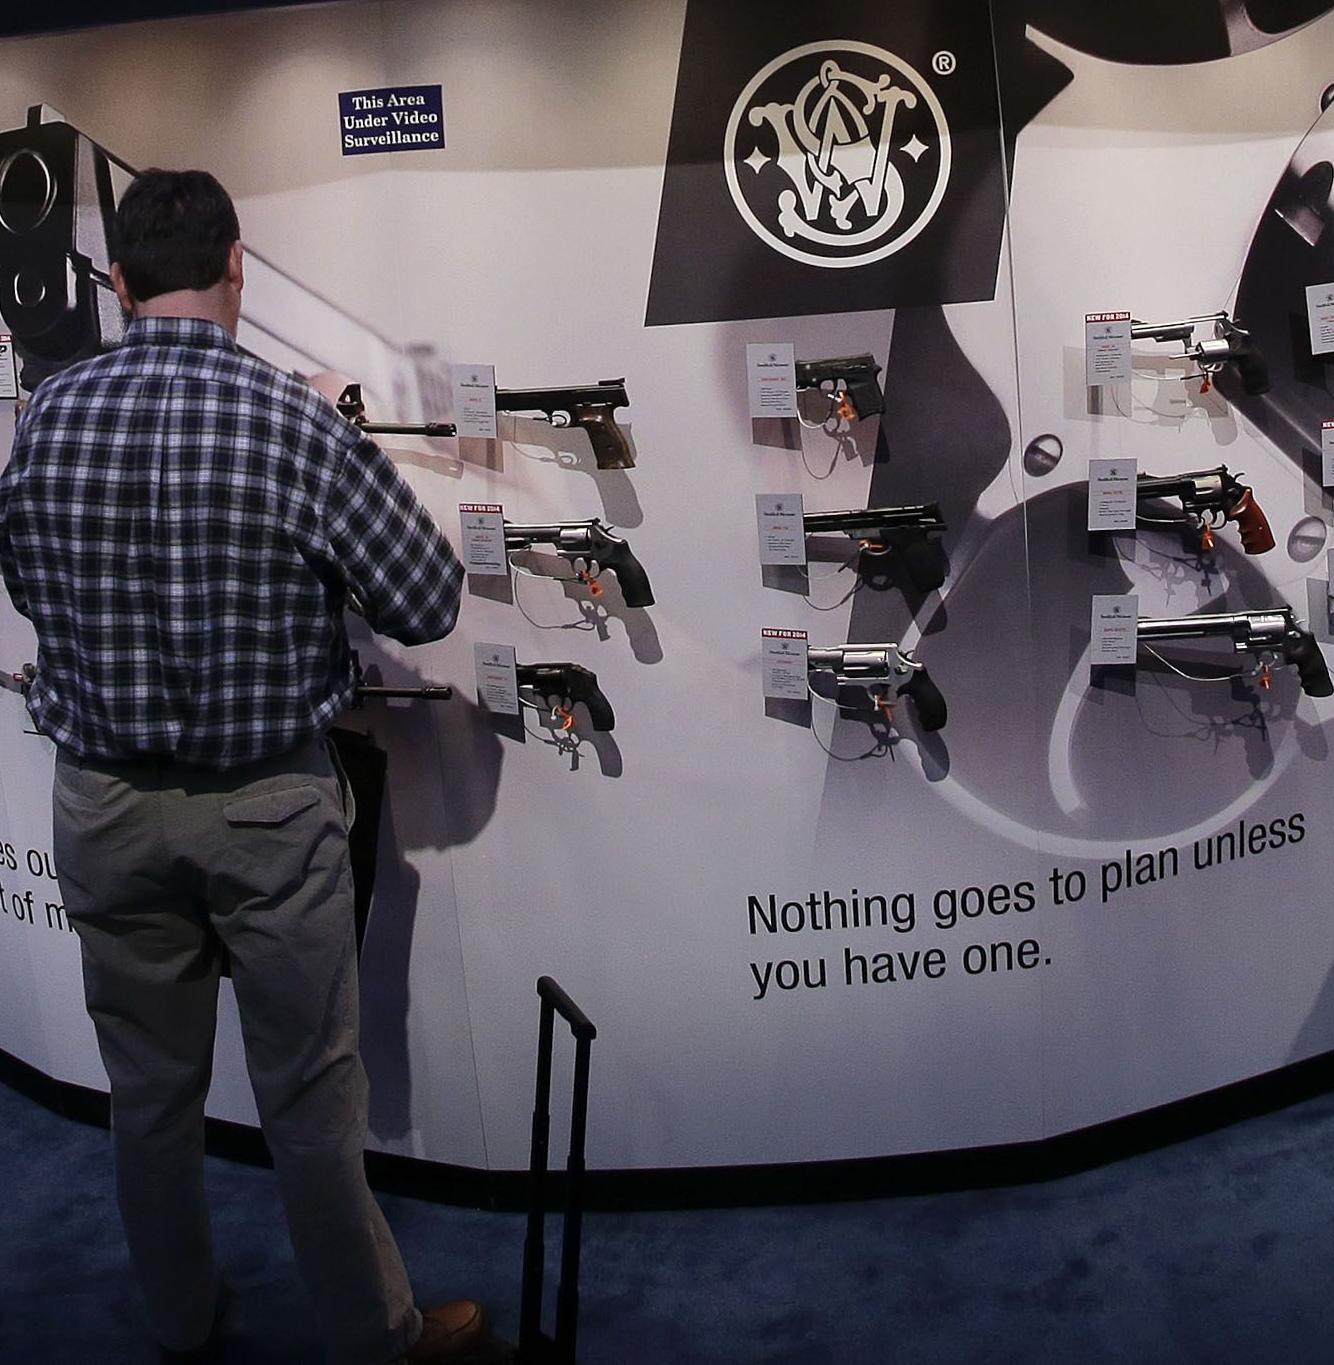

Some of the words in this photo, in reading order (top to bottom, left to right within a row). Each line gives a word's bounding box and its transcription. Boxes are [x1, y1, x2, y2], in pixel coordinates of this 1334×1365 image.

[352, 96, 384, 110] This
[387, 94, 425, 107] Area
[343, 114, 388, 130] Under
[391, 110, 438, 125] Video
[344, 131, 440, 148] Surveillance
[747, 890, 915, 933] Nothing
[933, 879, 1036, 930] goes
[1049, 867, 1086, 904] to
[1101, 845, 1178, 902] plan
[1192, 812, 1306, 871] unless
[13, 890, 35, 924] of
[749, 957, 827, 1000] you
[843, 946, 947, 985] have
[962, 937, 1052, 975] one.
